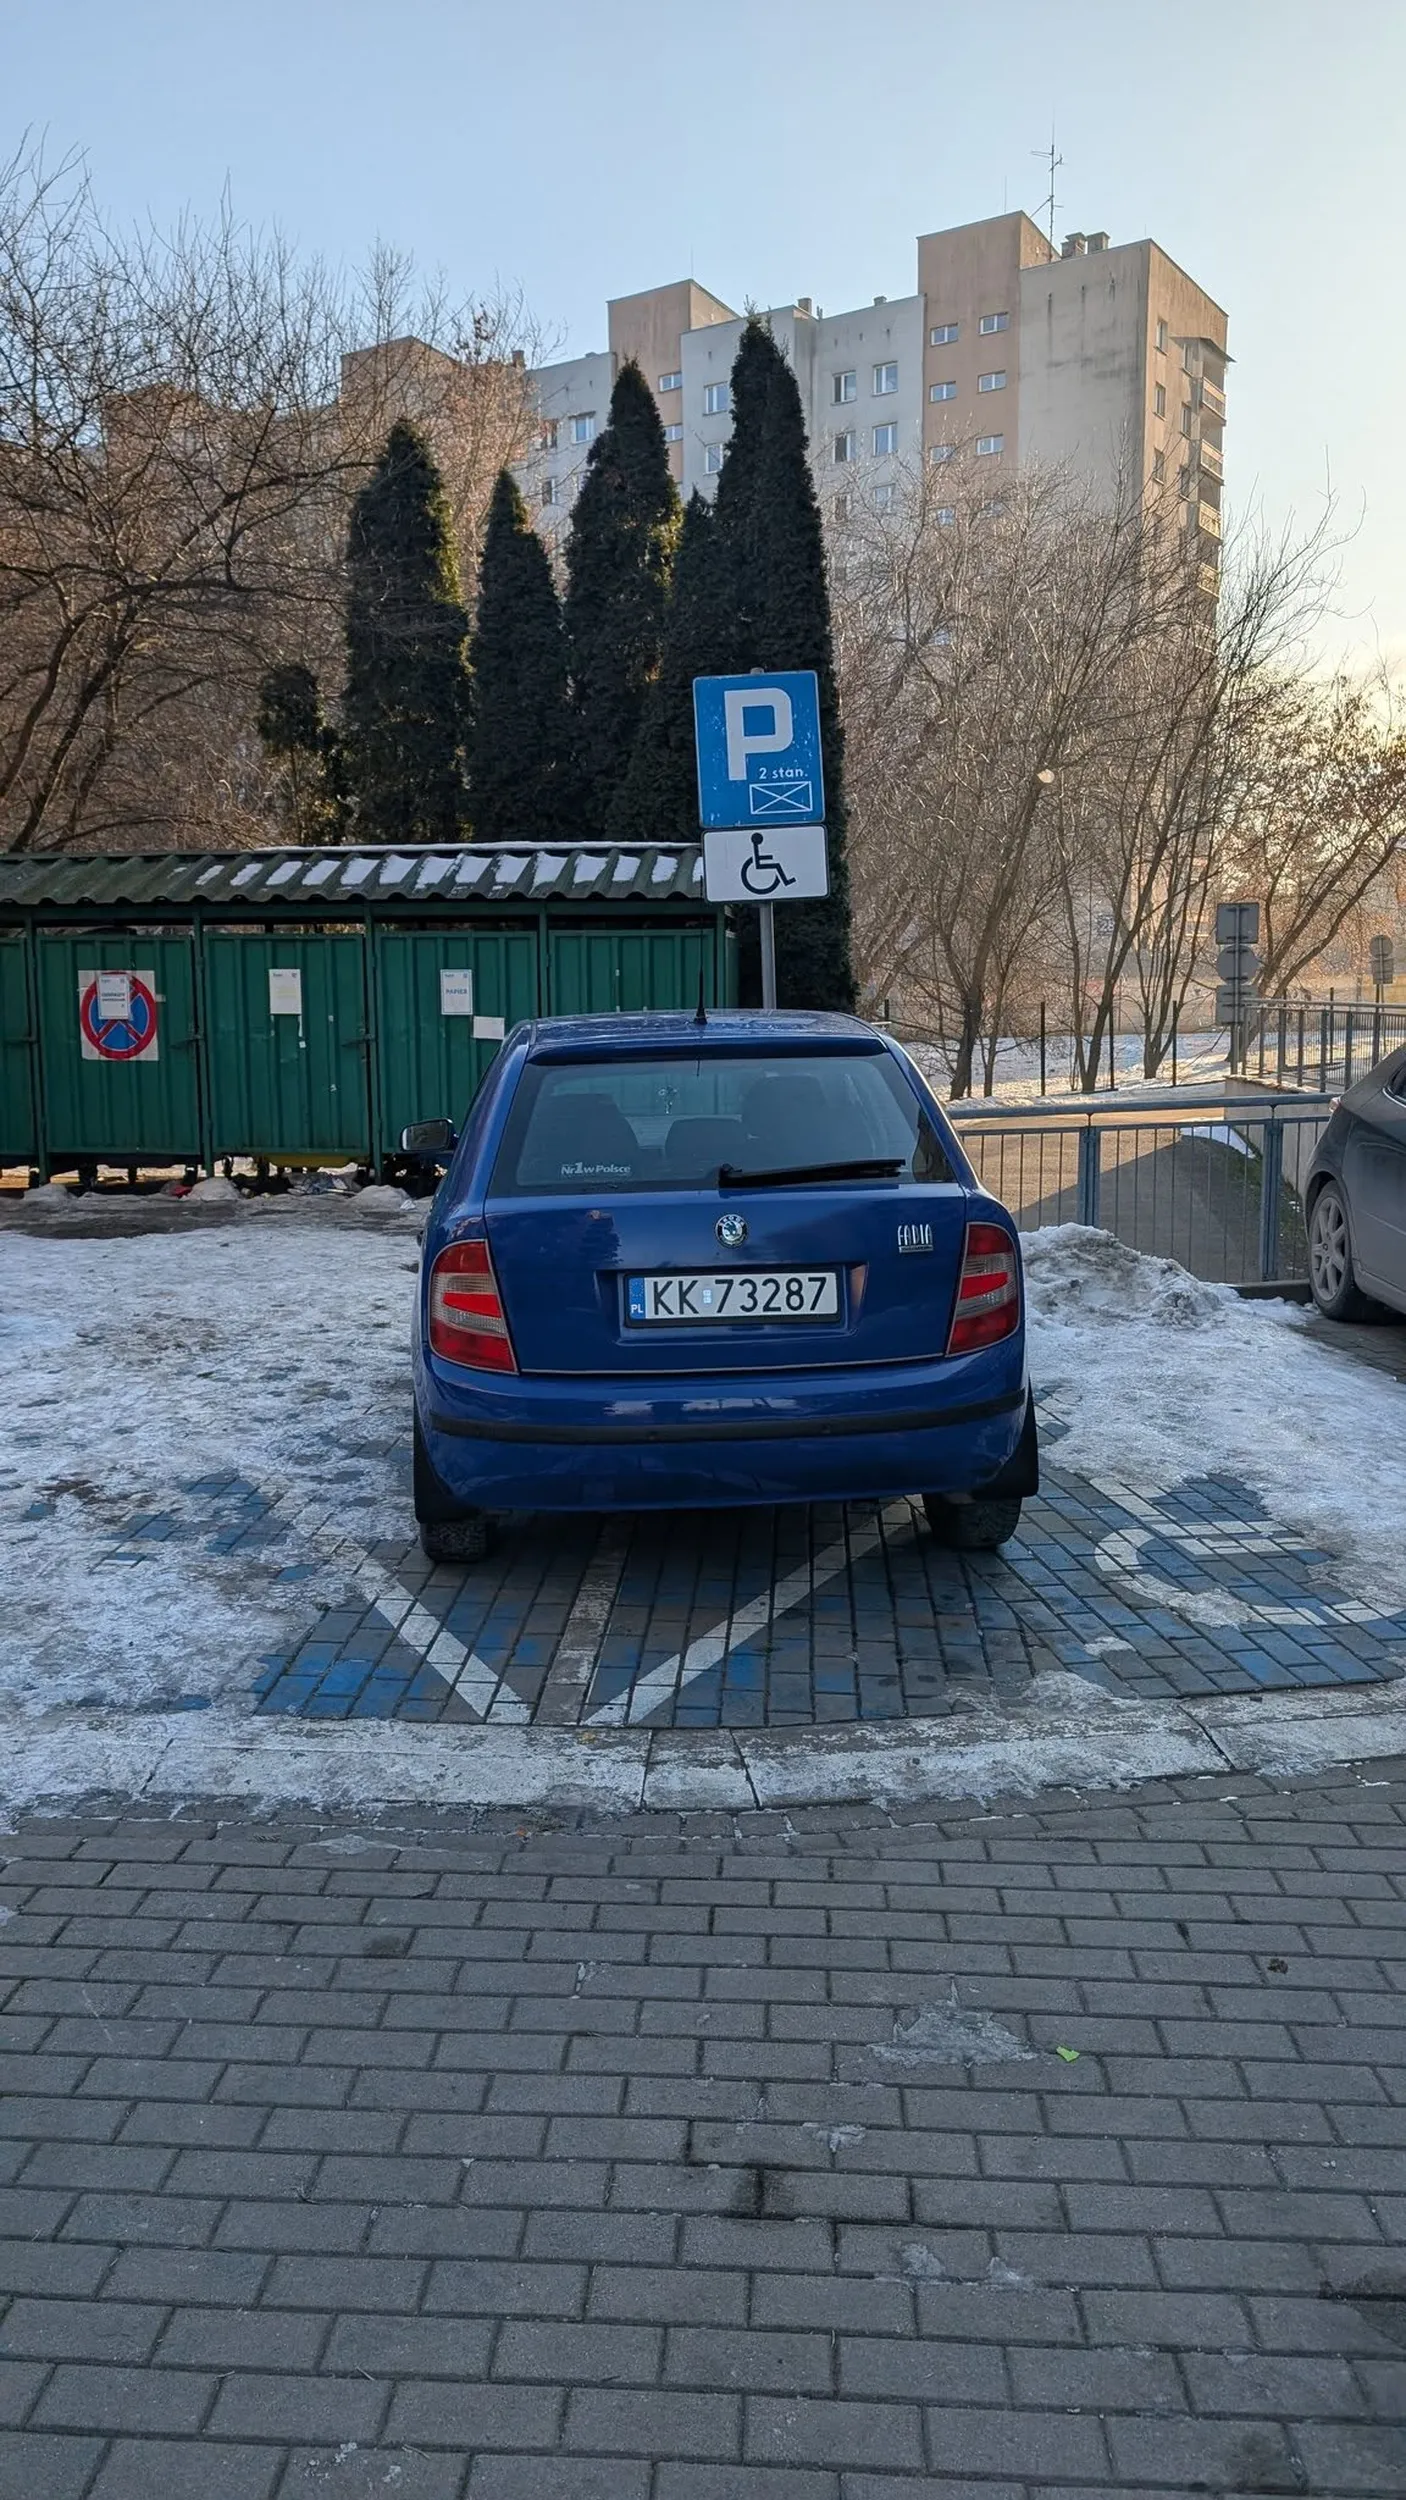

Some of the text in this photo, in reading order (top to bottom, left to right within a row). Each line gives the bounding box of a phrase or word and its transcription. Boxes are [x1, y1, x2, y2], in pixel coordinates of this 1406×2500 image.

[724, 687, 794, 781] P
[758, 766, 809, 780] 2 stan.
[595, 1164, 632, 1173] Polsce
[653, 1276, 827, 1315] KK 73287
[630, 1304, 644, 1314] PL
